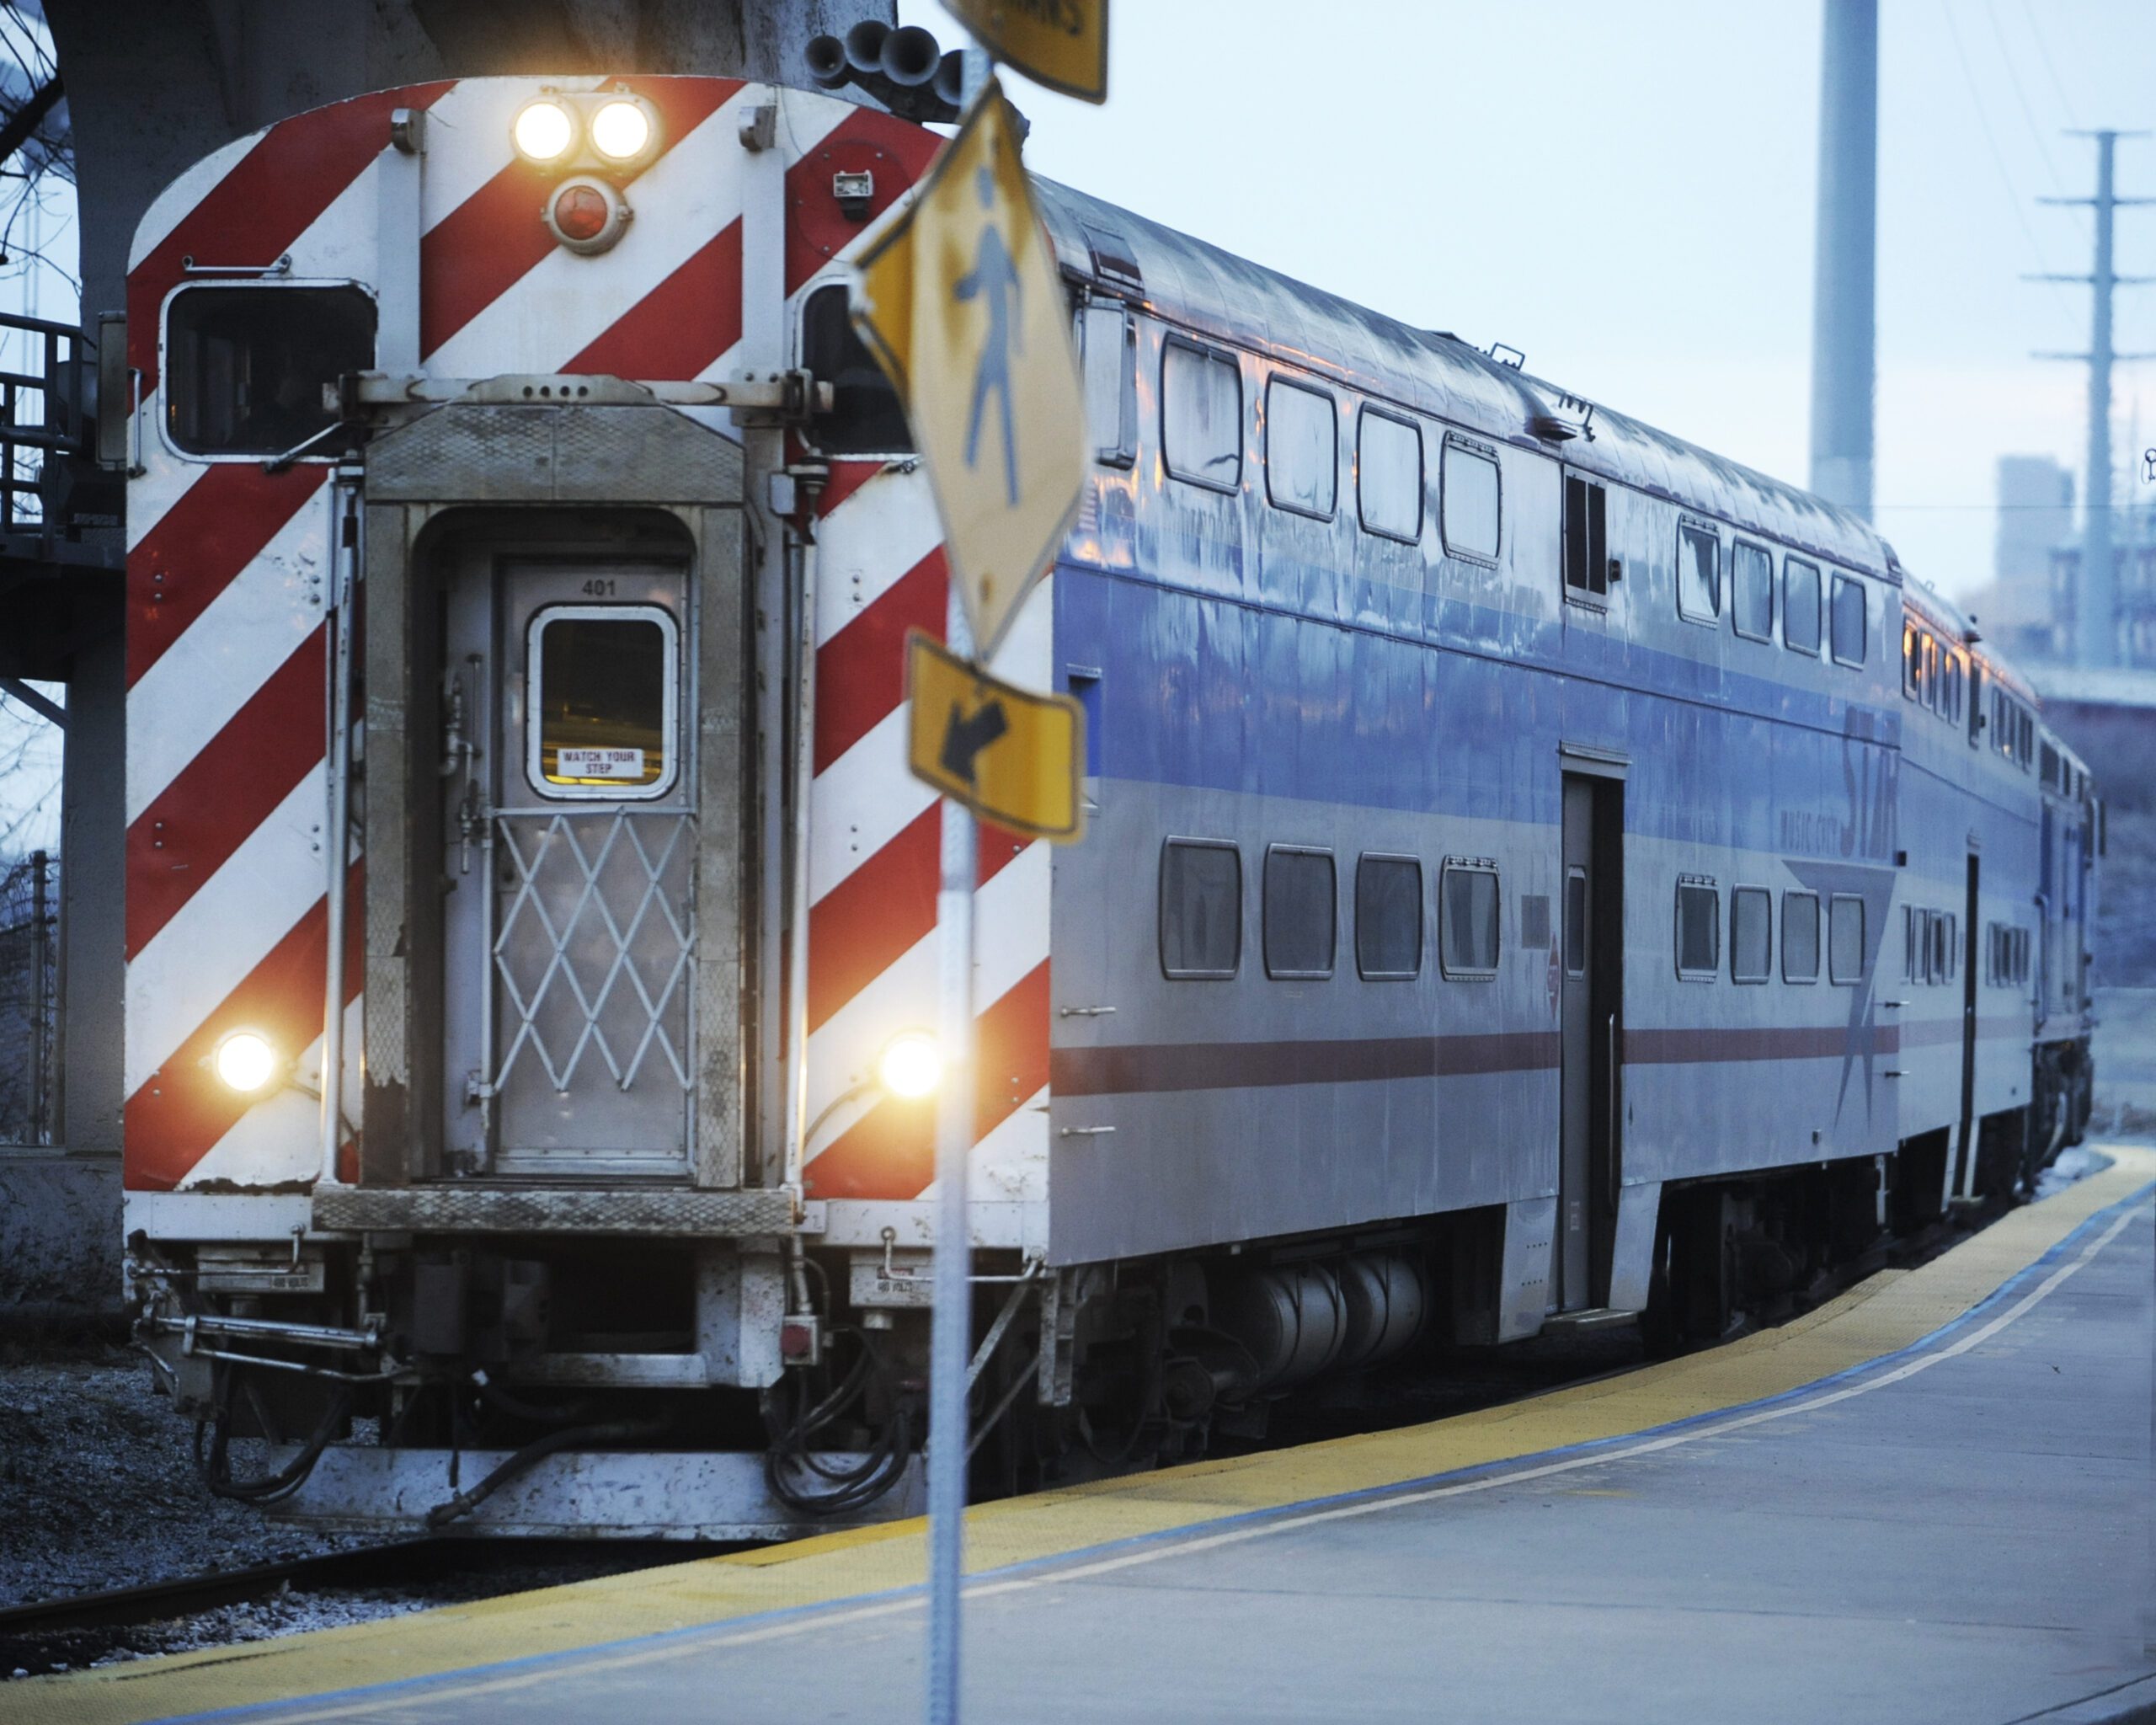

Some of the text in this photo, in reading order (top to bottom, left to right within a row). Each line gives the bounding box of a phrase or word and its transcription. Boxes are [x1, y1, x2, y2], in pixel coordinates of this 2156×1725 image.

[582, 579, 616, 595] 401
[563, 750, 634, 761] WATCH YOUR
[585, 763, 611, 773] STEP
